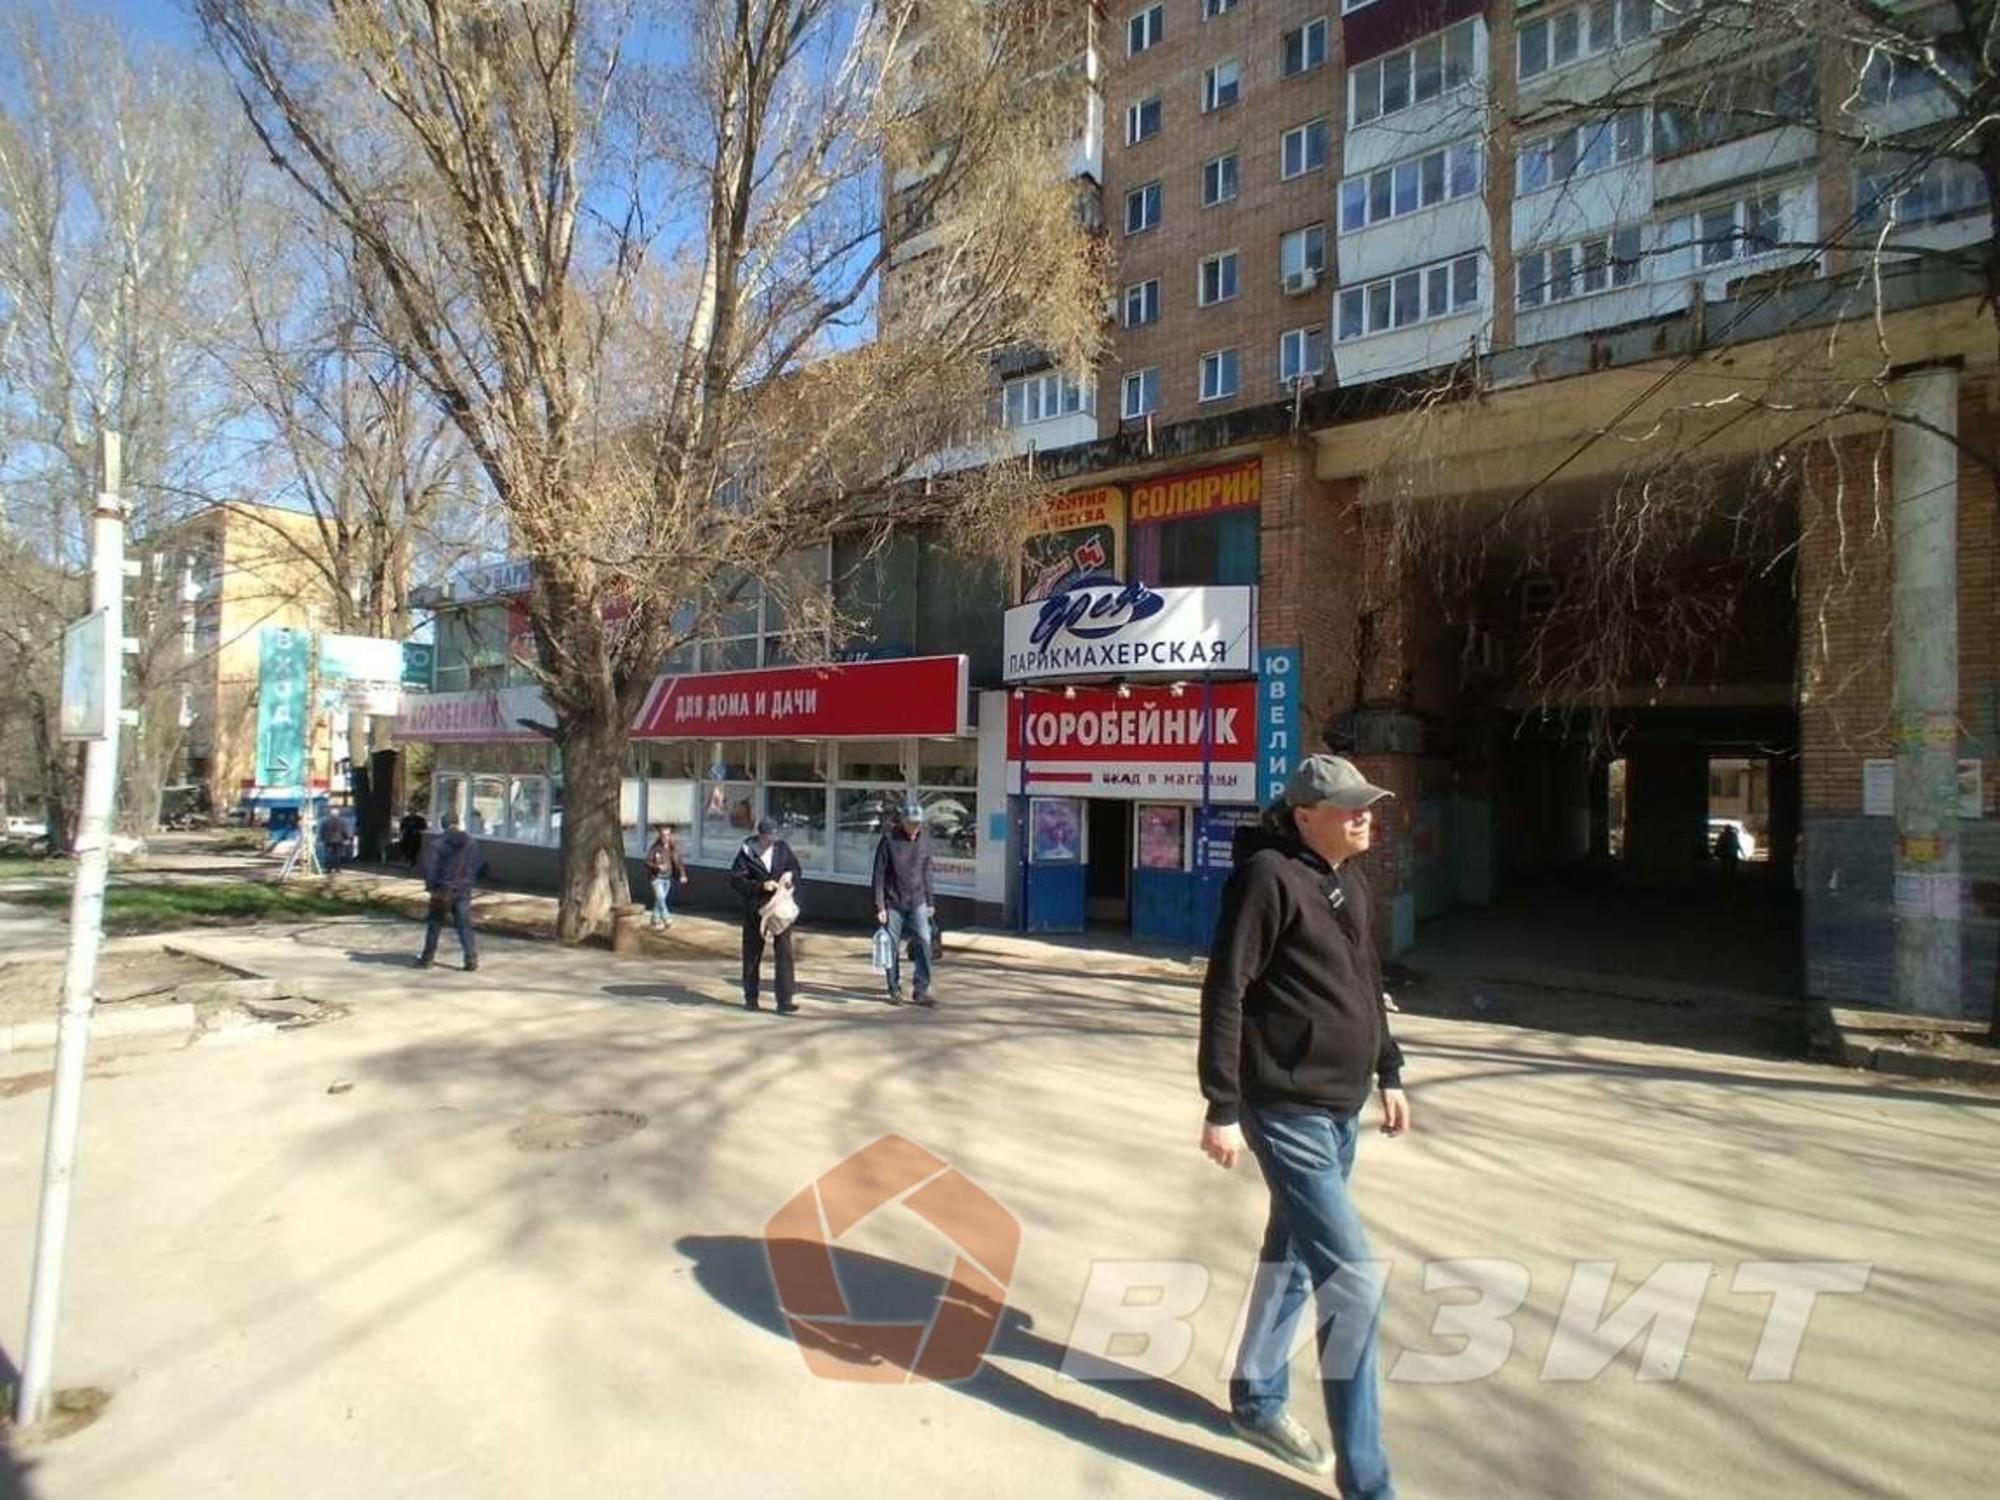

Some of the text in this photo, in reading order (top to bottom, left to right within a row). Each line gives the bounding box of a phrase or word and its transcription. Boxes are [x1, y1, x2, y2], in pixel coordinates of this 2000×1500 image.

[1131, 462, 1261, 520] СОЛЯРИЙ
[1008, 640, 1228, 675] ПАРИКМАХЕРСКАЯ
[707, 692, 750, 721] ДОМА
[755, 691, 767, 716] И
[771, 688, 817, 720] ДАЧИ
[1019, 701, 1239, 747] КОРОБЕЙНИК
[1265, 655, 1291, 799] ЮВЕЛИР
